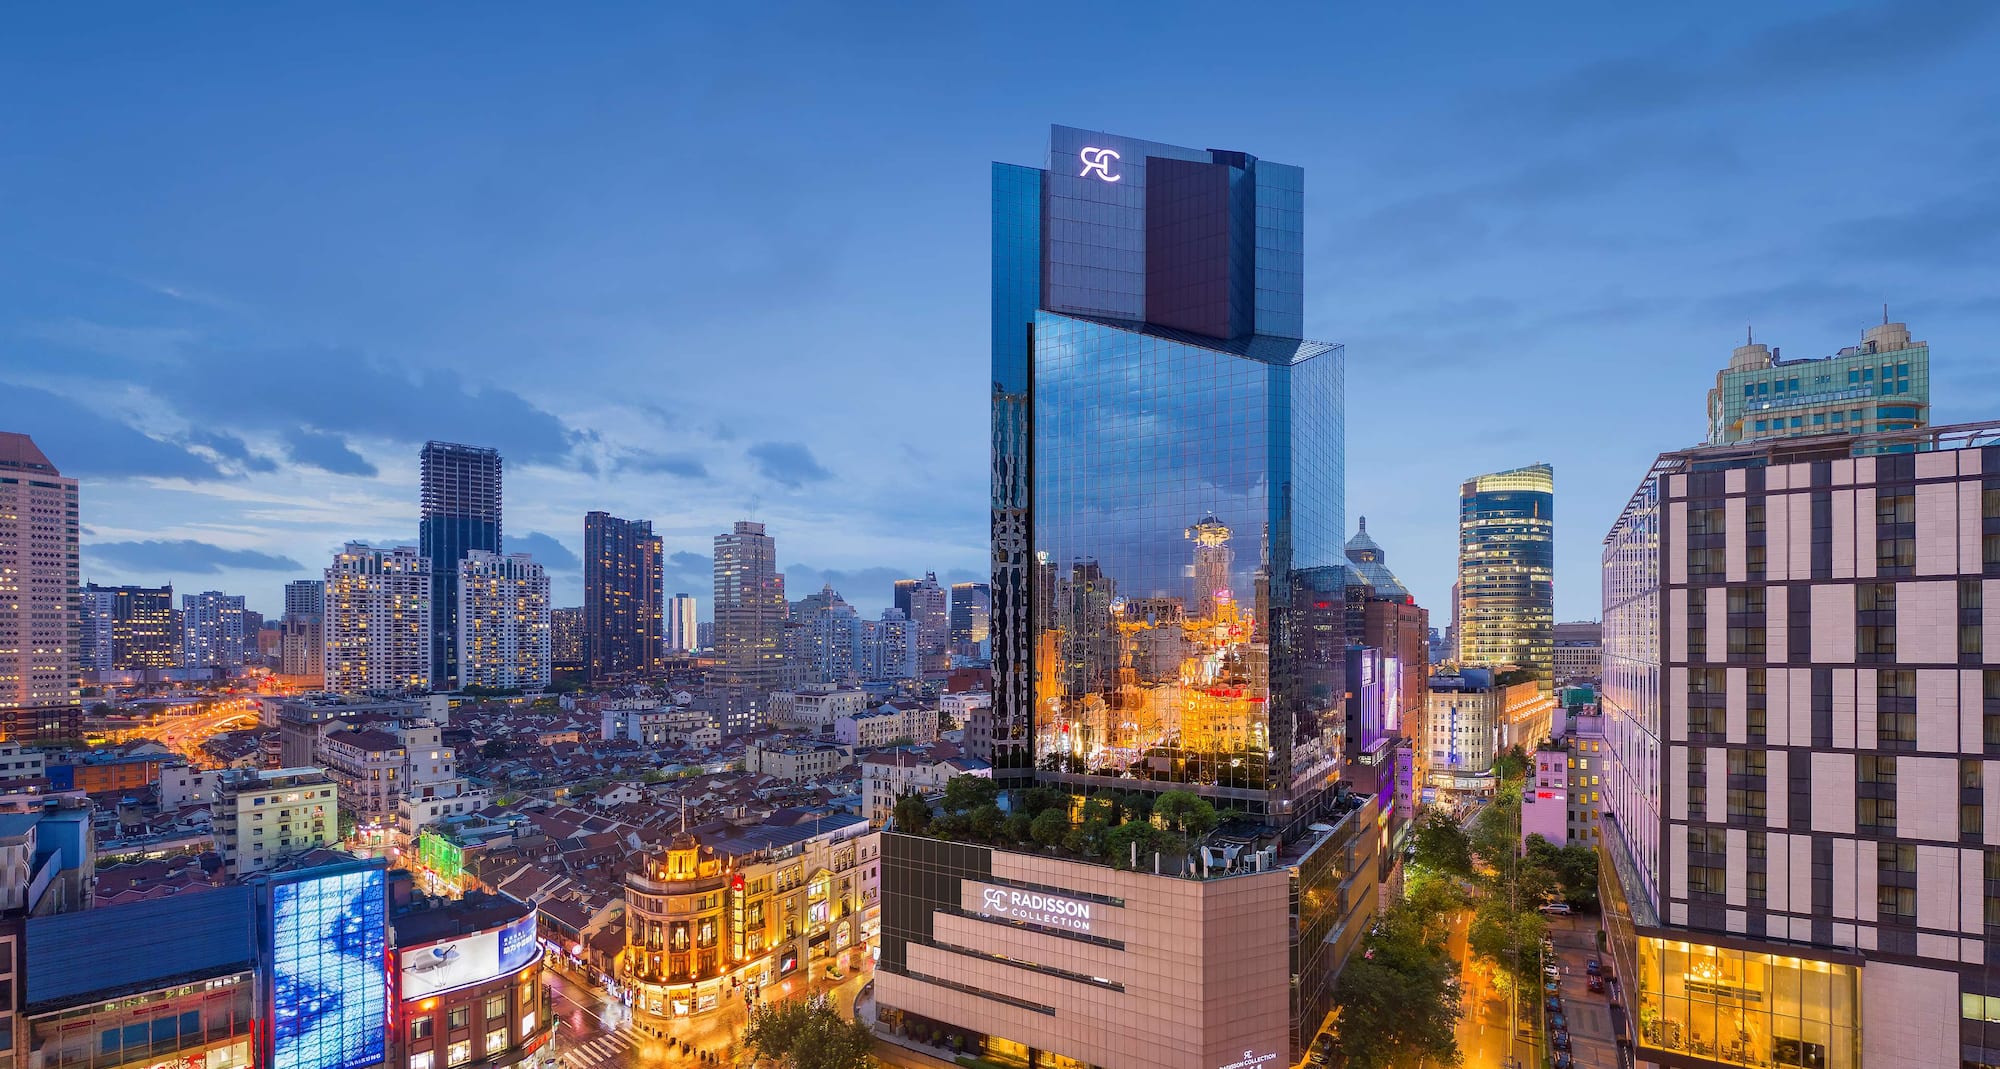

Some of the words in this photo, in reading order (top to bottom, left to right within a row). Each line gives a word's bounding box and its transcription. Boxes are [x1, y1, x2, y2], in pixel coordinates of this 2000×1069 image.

[1011, 891, 1090, 919] RADISSON
[1011, 908, 1090, 930] COLLECTION
[344, 1053, 381, 1068] SAMSUNG
[1244, 1053, 1276, 1066] COLLECTION
